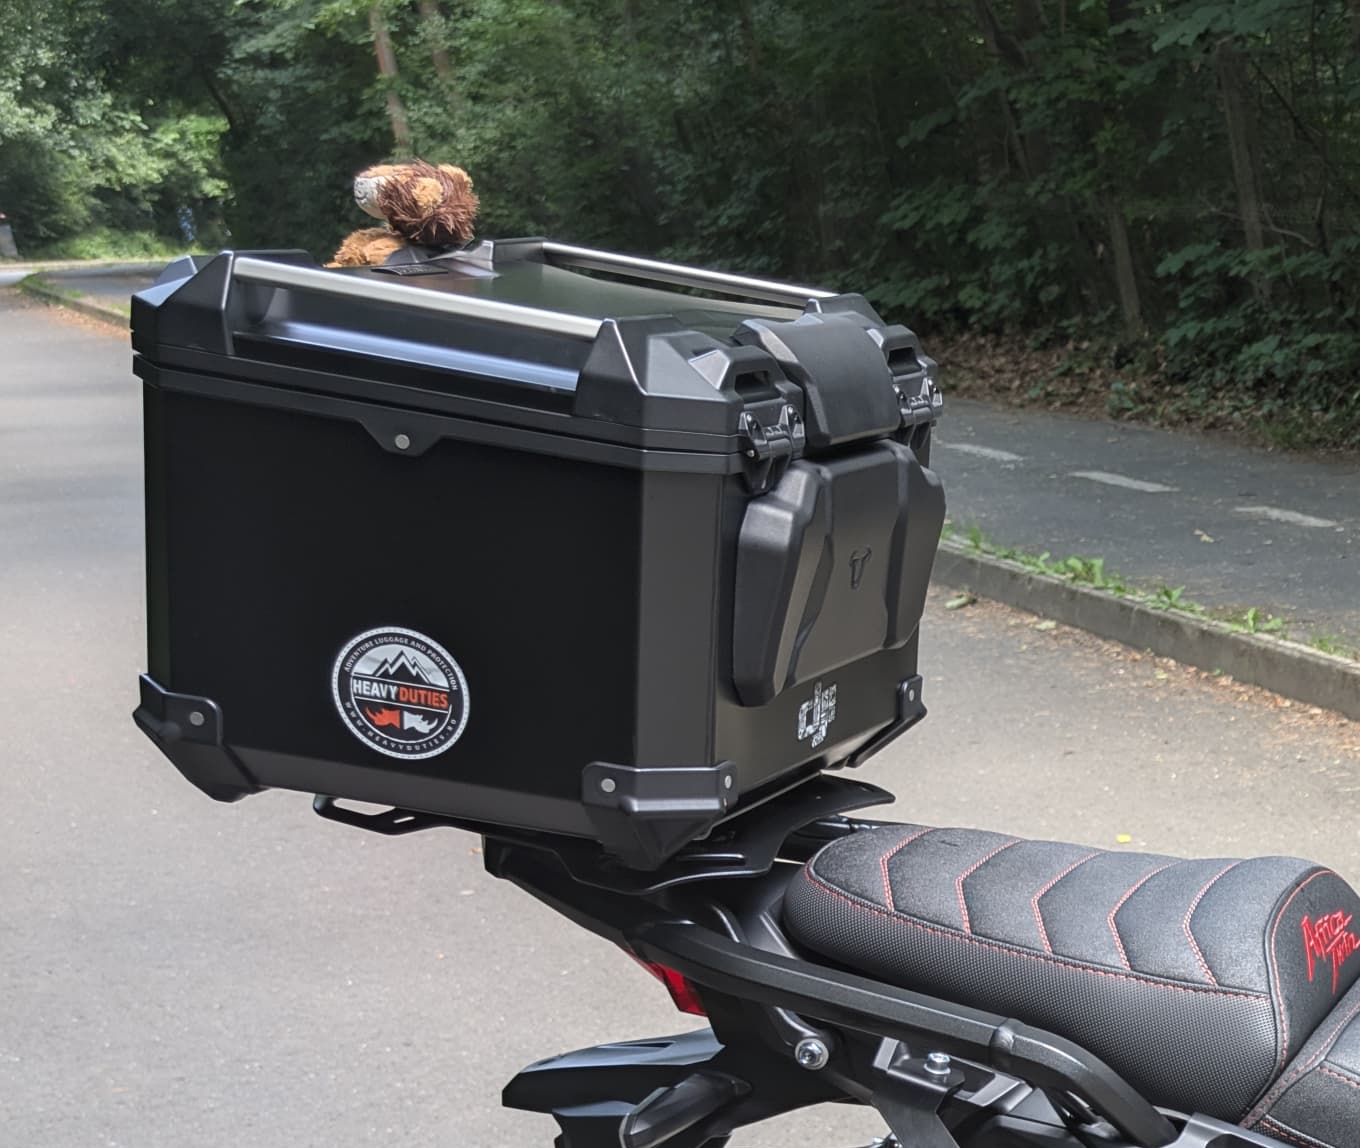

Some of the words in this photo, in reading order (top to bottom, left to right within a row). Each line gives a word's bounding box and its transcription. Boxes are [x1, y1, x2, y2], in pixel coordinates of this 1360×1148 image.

[344, 639, 374, 673] ADVENTURE
[375, 636, 409, 645] LUGGAGE
[410, 638, 427, 651] AND
[427, 649, 458, 691] PROTECTION
